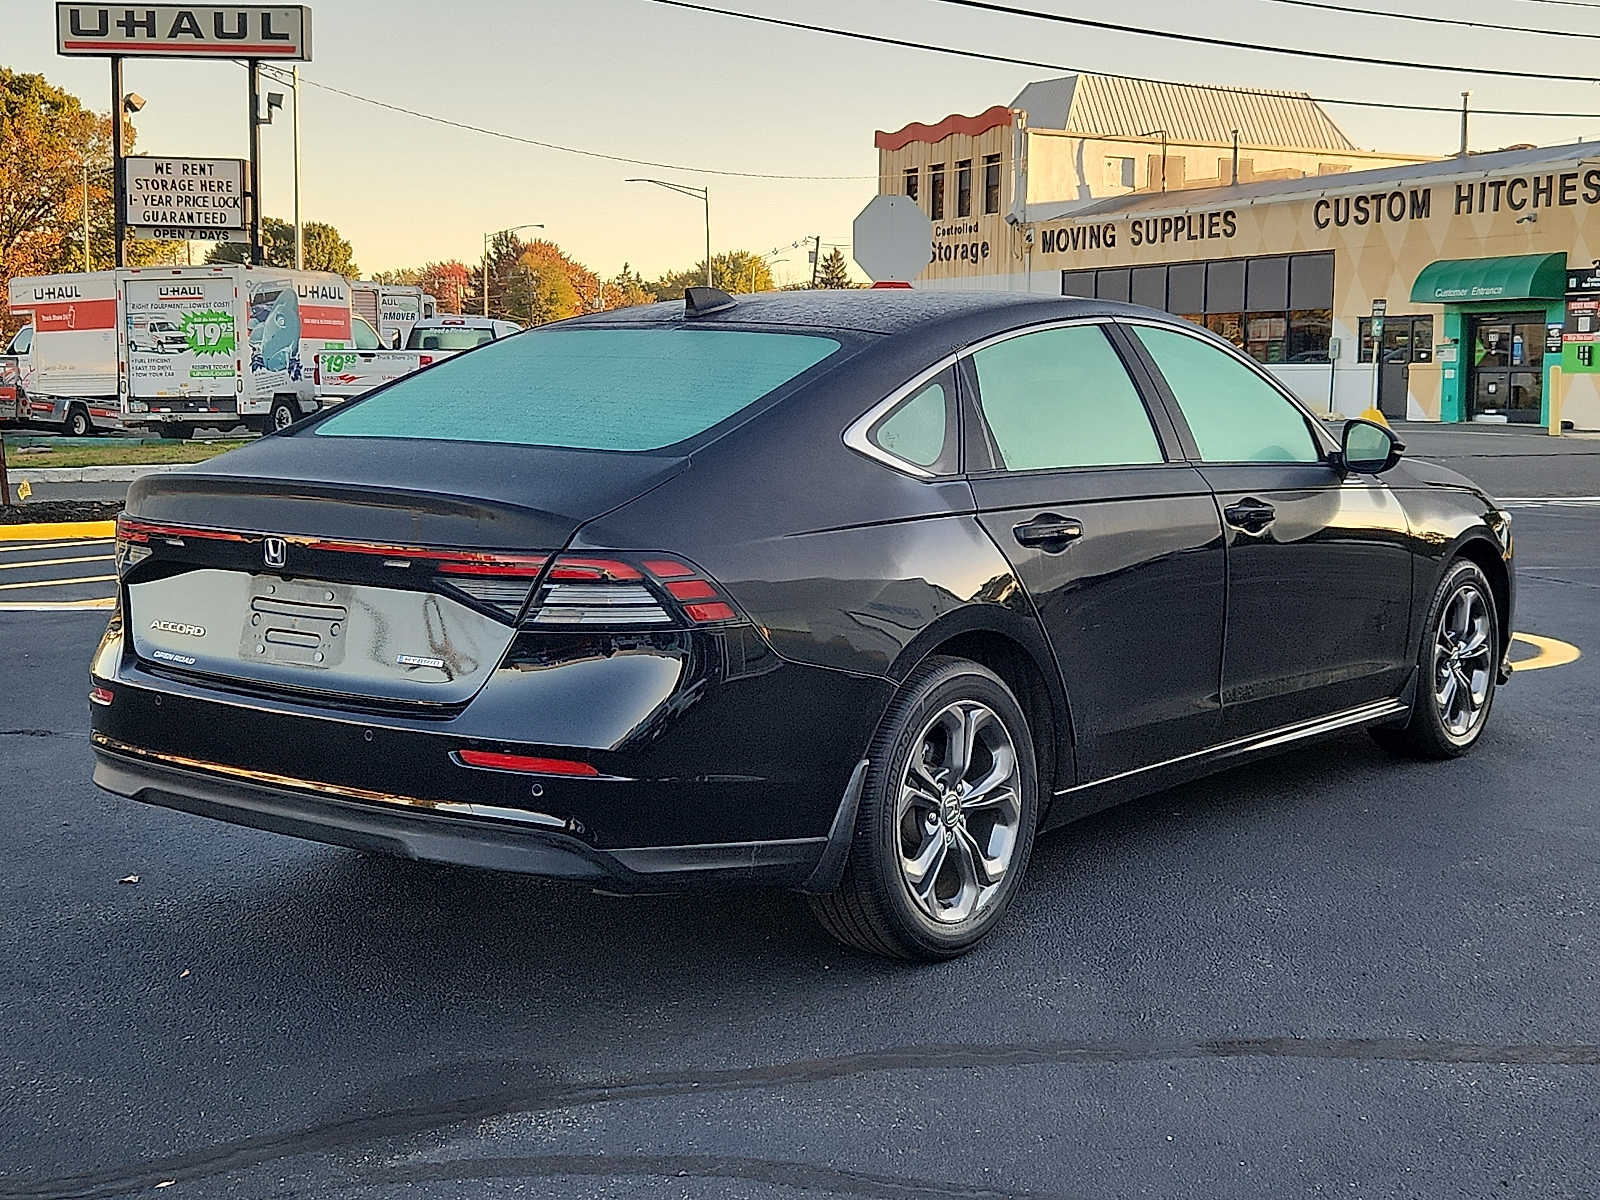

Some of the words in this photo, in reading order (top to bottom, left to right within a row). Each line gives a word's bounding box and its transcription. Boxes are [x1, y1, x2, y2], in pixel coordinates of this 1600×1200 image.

[154, 162, 173, 175] WE
[182, 163, 215, 176] RENT
[135, 178, 194, 192] STORAGE
[200, 180, 233, 193] HERE
[142, 194, 173, 207] YEAR
[176, 196, 209, 208] PRICE
[212, 196, 240, 208] LOCK
[1313, 188, 1431, 229] CUSTOM
[1455, 169, 1600, 215] HITCHES
[142, 210, 227, 224] GUARANTEED
[153, 229, 185, 239] OPEN
[189, 230, 196, 239] 7
[199, 230, 230, 241] DAYS
[935, 222, 979, 237] Controlled
[1041, 223, 1116, 253] MOVING
[1130, 210, 1207, 247] SUPPLIES
[1435, 288, 1468, 298] Customer
[1471, 286, 1503, 296] Entrance
[383, 312, 416, 320] RMOVER
[150, 620, 207, 638] ACCORD
[153, 650, 174, 661] OPEN
[173, 655, 196, 665] ROAD
